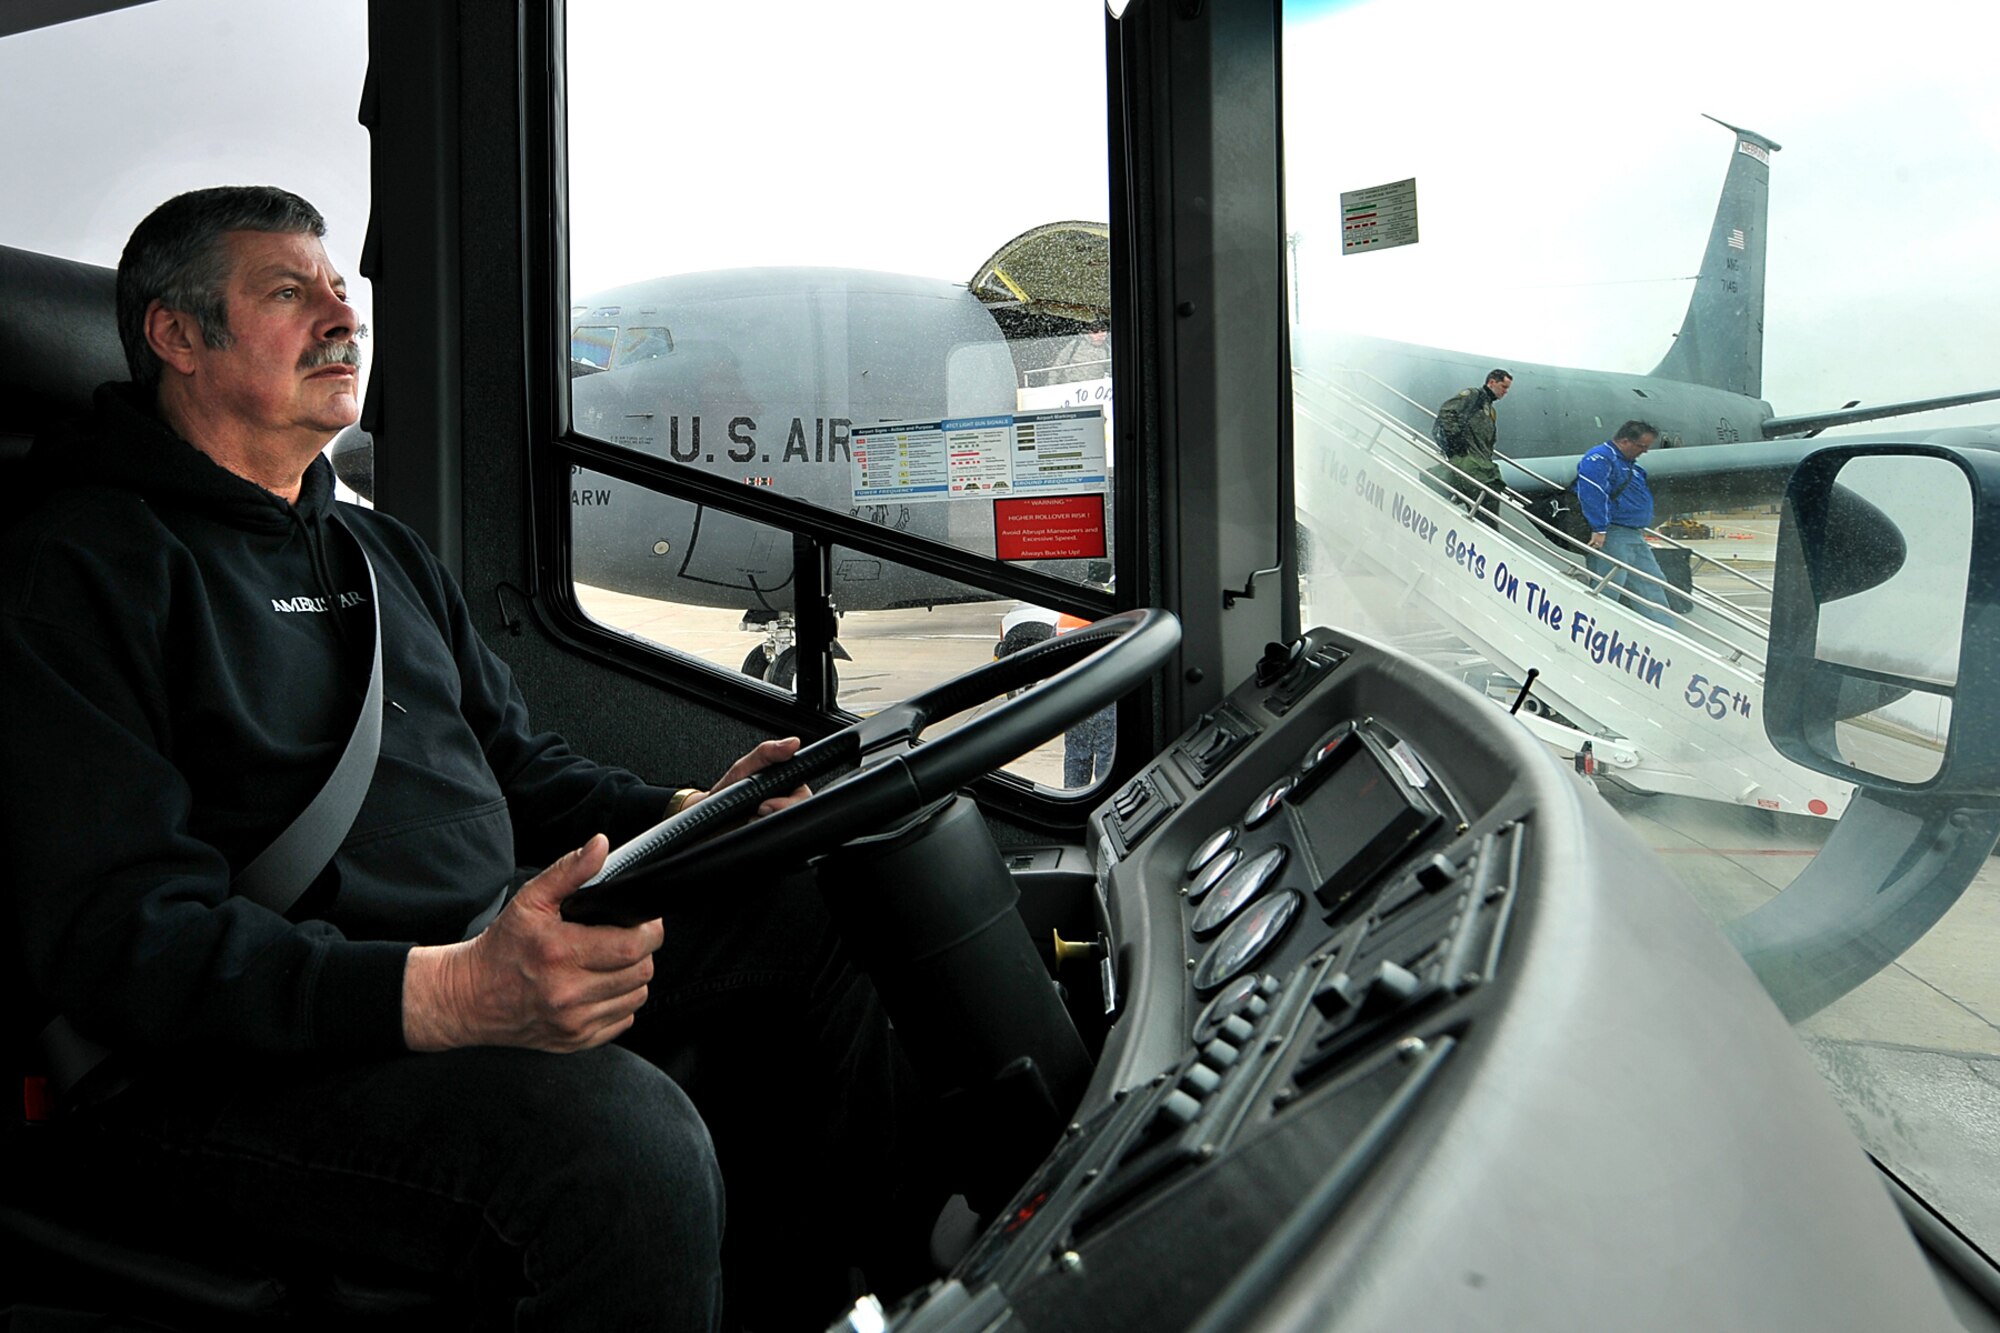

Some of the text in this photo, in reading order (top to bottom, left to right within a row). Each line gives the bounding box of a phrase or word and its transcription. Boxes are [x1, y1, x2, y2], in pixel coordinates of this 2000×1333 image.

[782, 417, 851, 463] AIR
[1319, 446, 1349, 487] The
[1355, 469, 1386, 512] Sun
[1392, 492, 1439, 545] Never
[1445, 529, 1487, 580] Sets
[1494, 562, 1519, 604] On
[1526, 581, 1563, 631] The
[1570, 610, 1672, 690] Fightin'
[271, 591, 367, 613] AMERIAR
